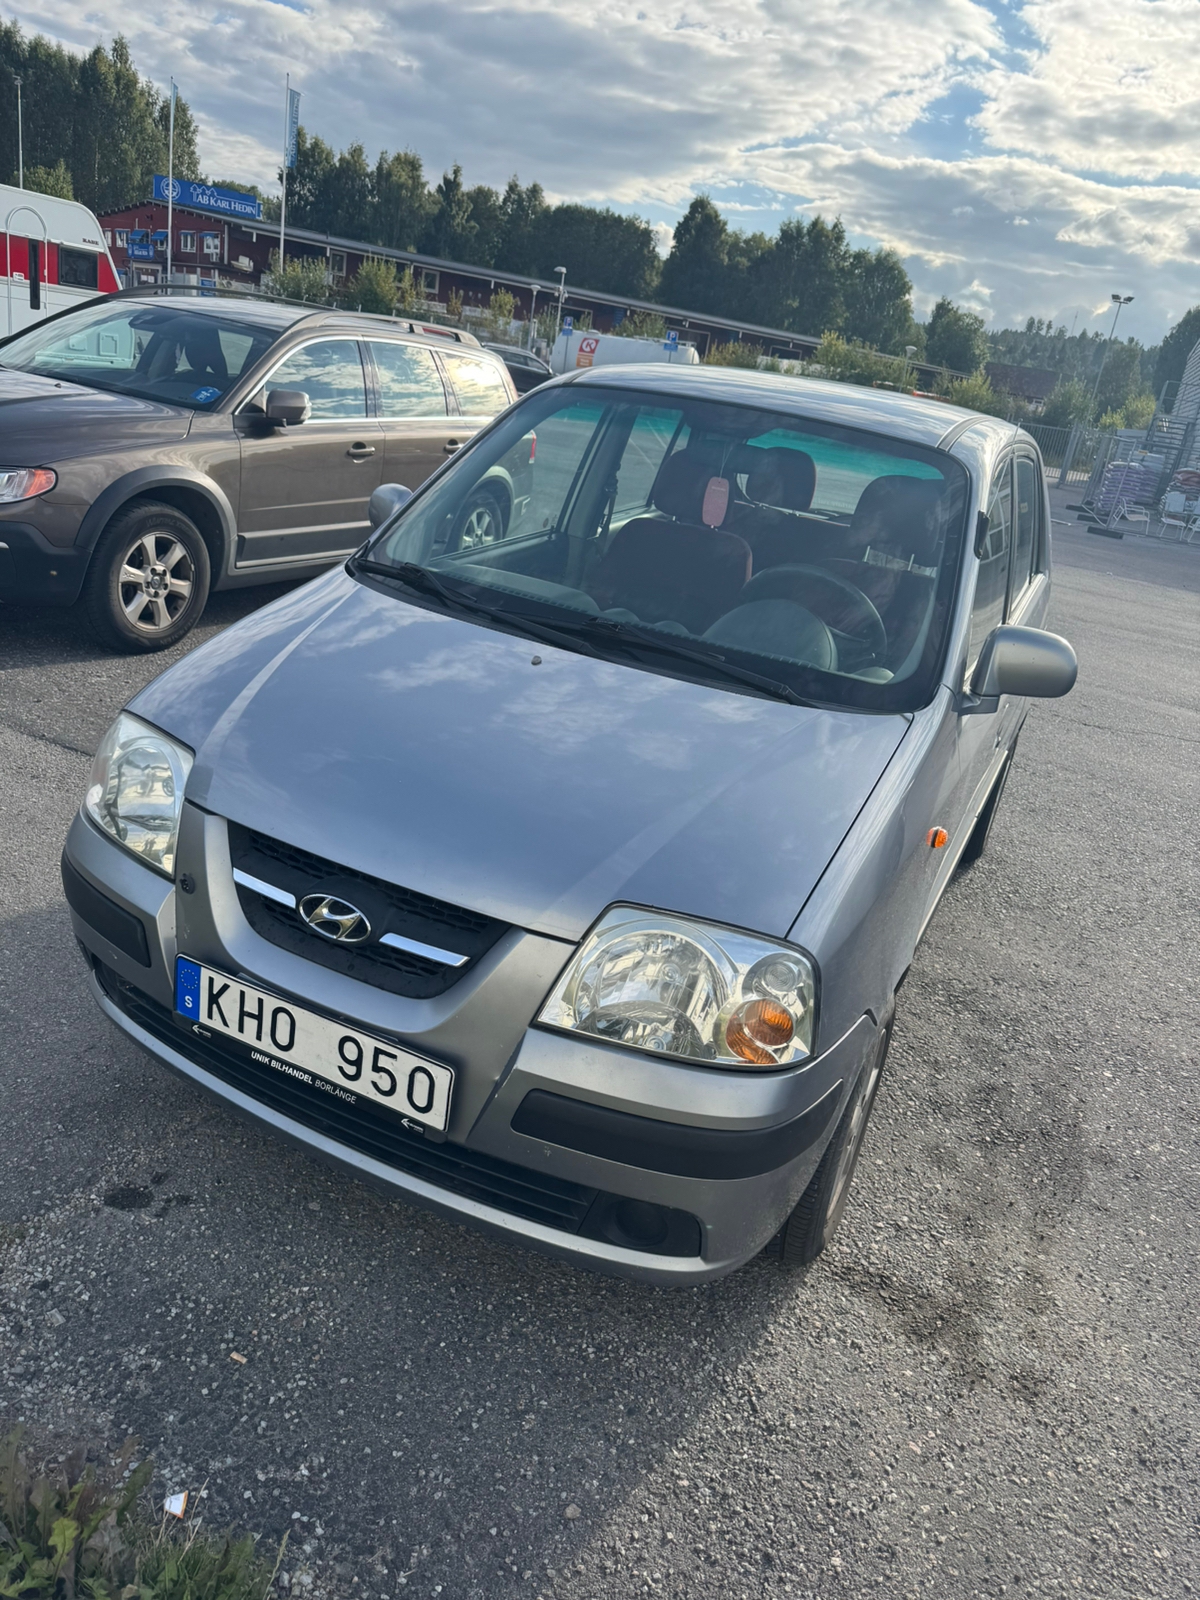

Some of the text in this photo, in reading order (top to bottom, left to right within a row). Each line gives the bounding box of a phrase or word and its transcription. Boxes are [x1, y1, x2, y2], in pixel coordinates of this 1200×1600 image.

[197, 195, 256, 215] AB KARL HEDIN
[669, 331, 676, 341] P
[585, 341, 594, 350] K
[184, 995, 193, 1008] S
[207, 975, 436, 1114] KHO 950
[250, 1050, 357, 1105] UNIK BILHANDEL BORLÄNGE
